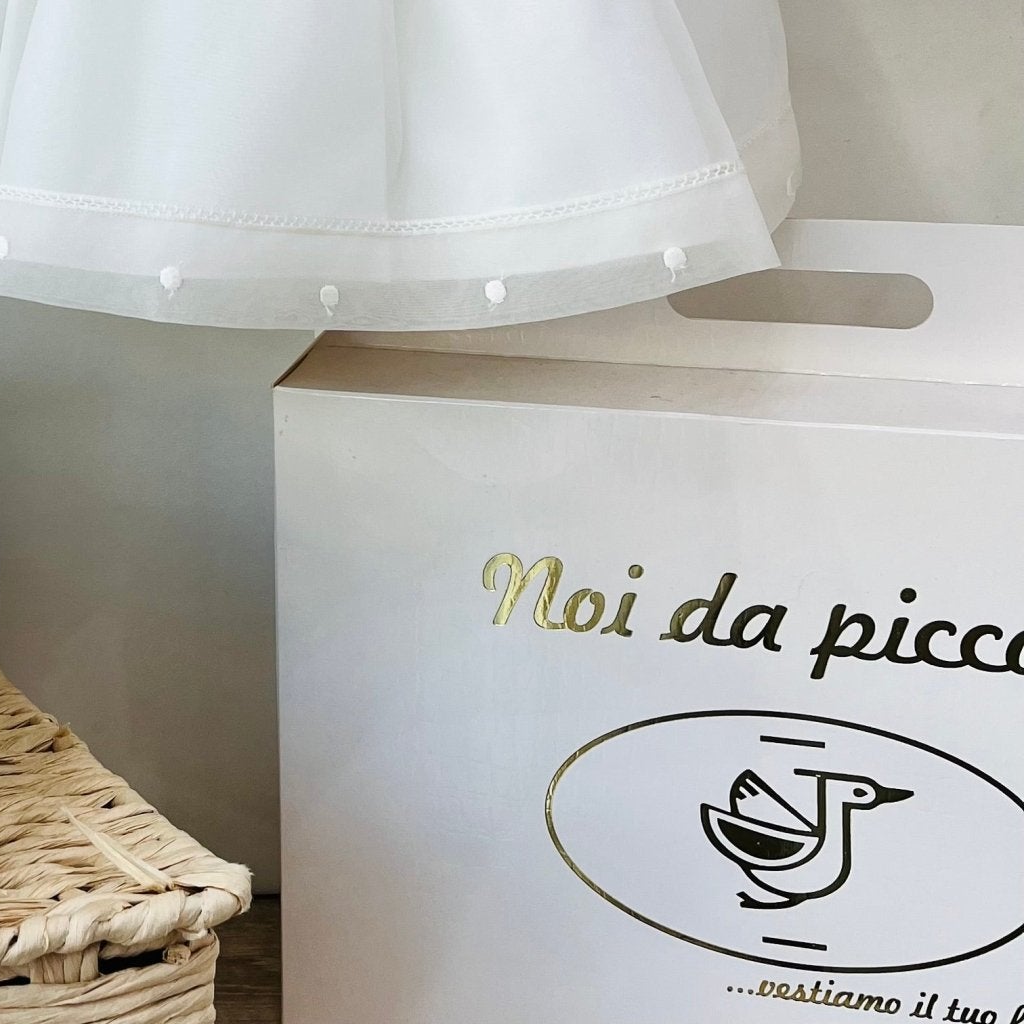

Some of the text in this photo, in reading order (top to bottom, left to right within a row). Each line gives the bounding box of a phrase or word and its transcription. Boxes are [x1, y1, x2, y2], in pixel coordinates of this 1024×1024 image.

[482, 552, 645, 638] Noi
[659, 572, 788, 653] da
[909, 991, 939, 1020] il
[942, 998, 998, 1024] tuo
